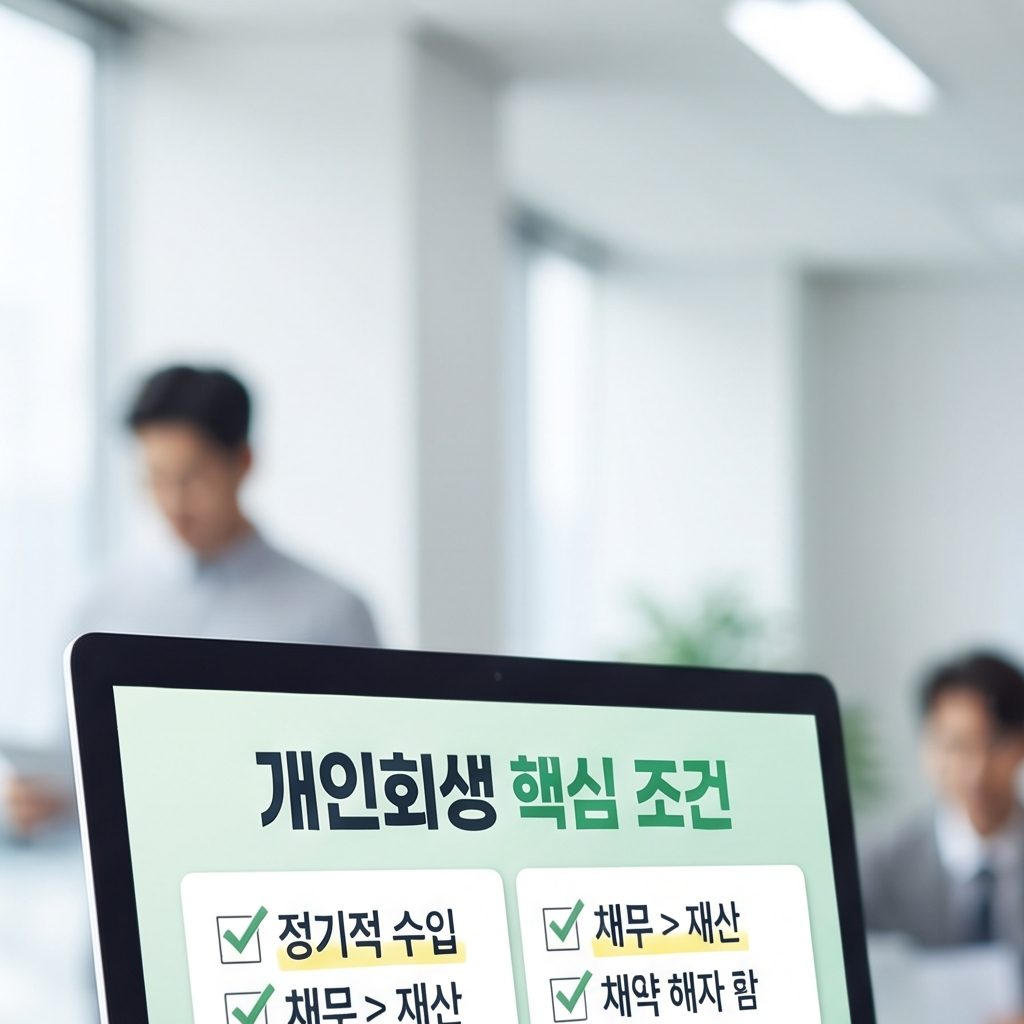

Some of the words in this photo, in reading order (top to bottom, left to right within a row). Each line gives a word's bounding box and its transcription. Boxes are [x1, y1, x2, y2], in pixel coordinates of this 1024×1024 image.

[256, 751, 497, 831] 개인회생
[510, 755, 619, 830] 핵심
[634, 760, 732, 830] 조건
[278, 910, 381, 960] 정기적
[393, 909, 457, 957] 수입
[594, 904, 653, 948] 채무
[661, 914, 679, 935] >
[686, 901, 740, 944] 재산
[365, 996, 386, 1022] >
[668, 970, 725, 1013] 해자
